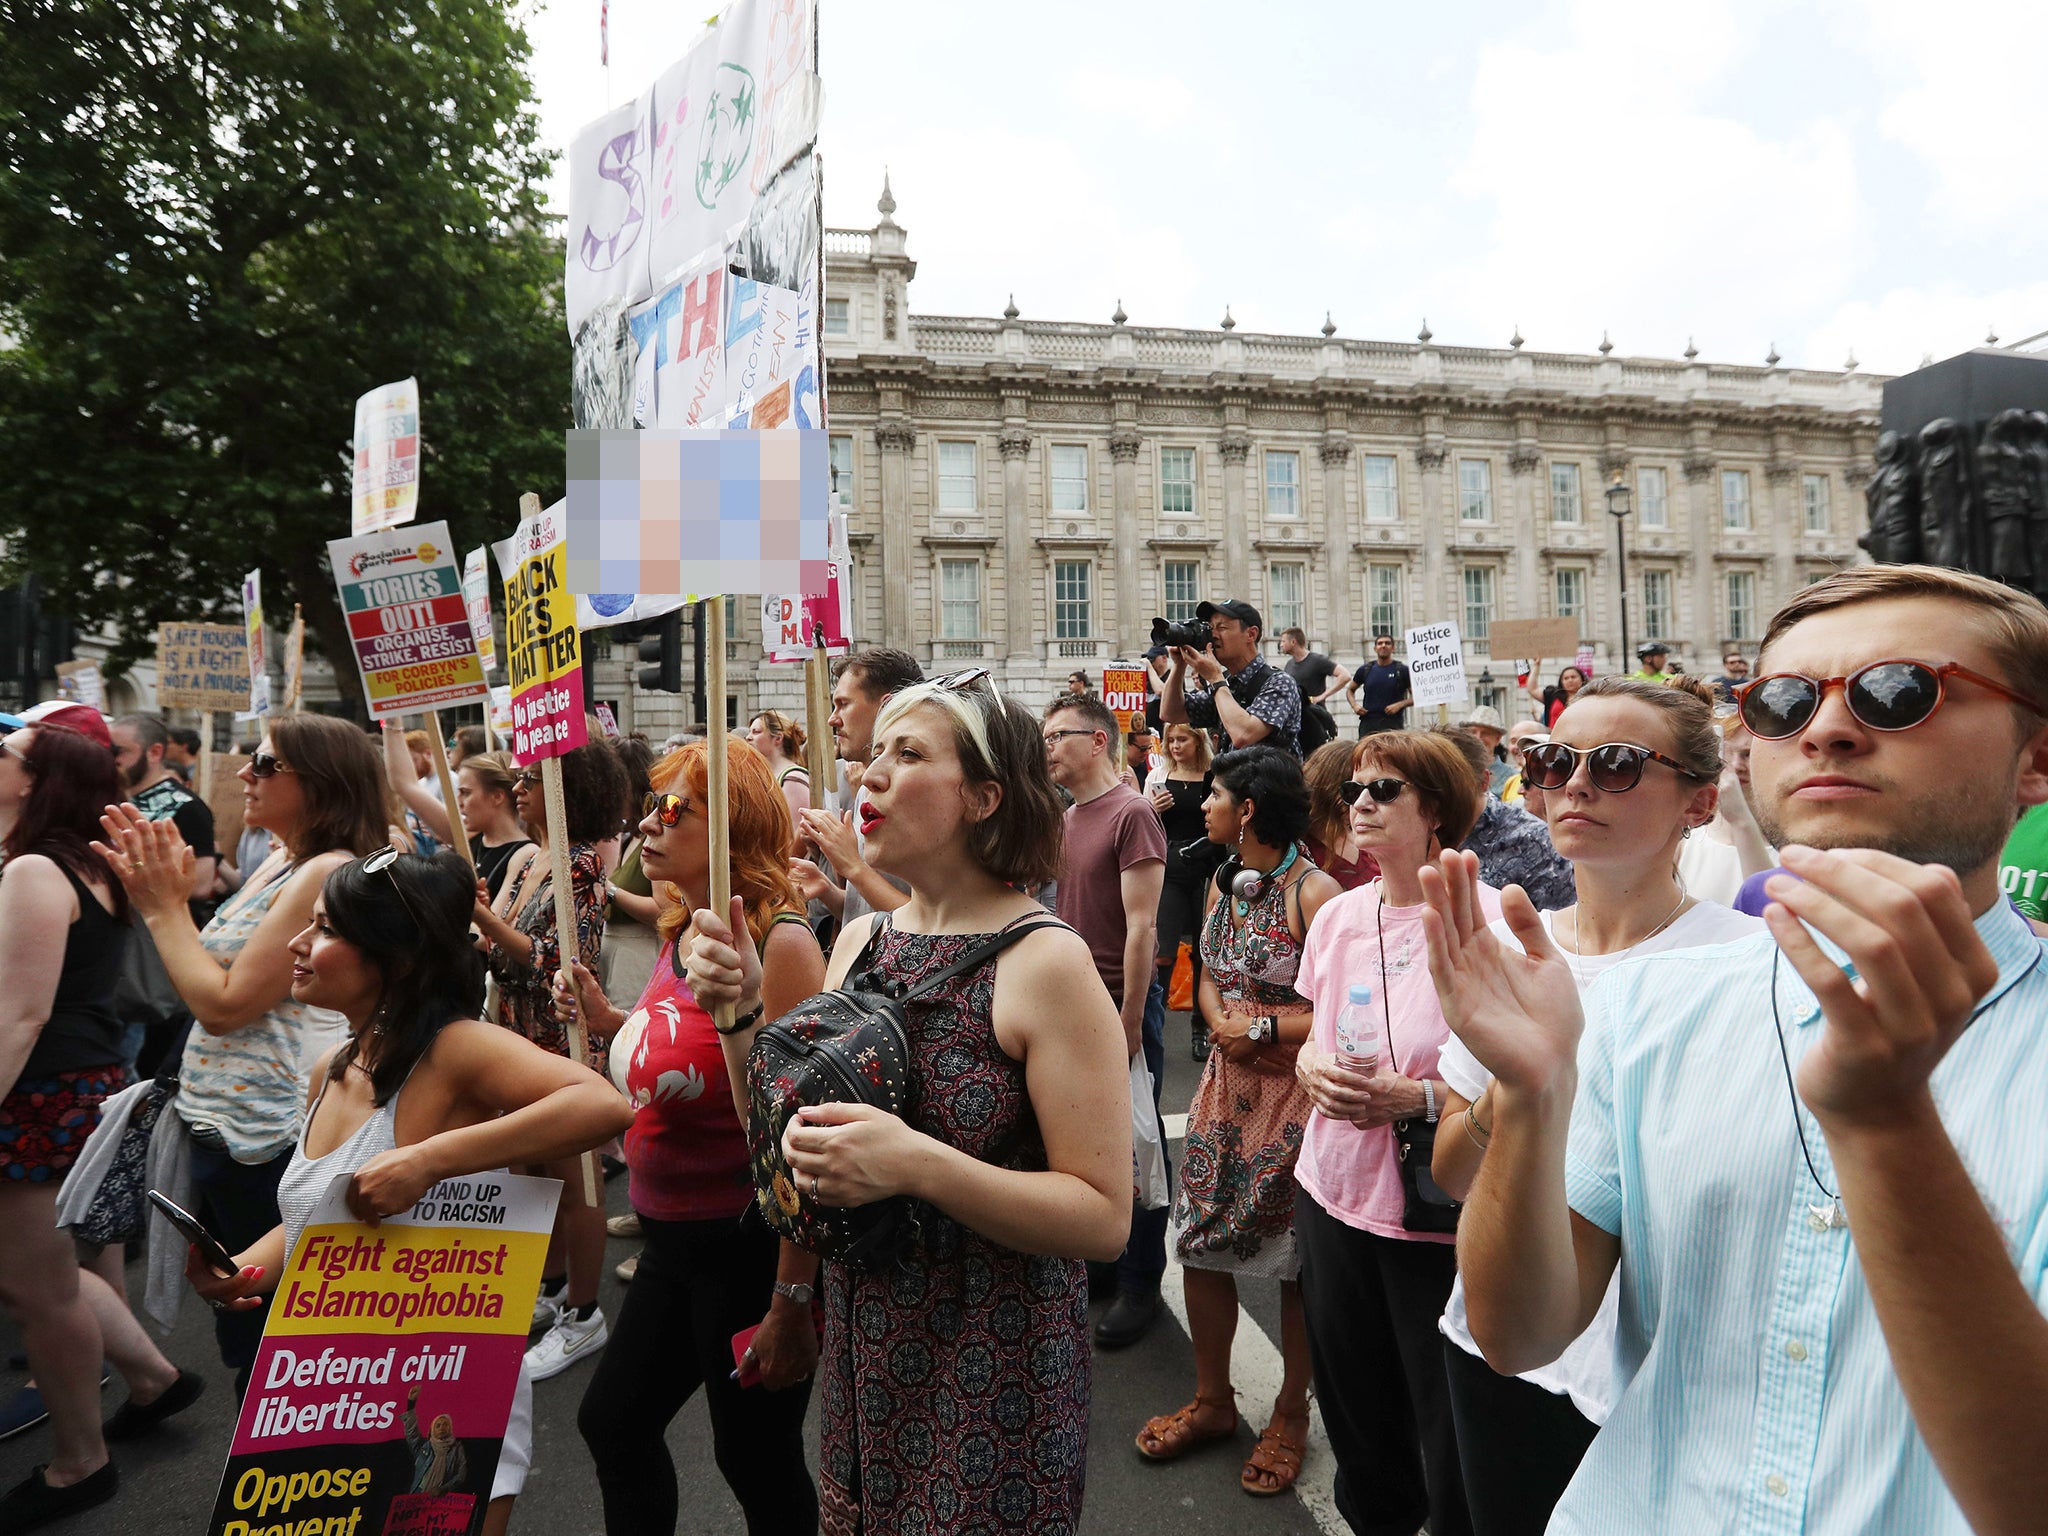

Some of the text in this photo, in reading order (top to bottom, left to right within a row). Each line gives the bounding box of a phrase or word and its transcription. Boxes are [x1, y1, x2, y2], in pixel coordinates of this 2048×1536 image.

[629, 267, 762, 371] THE
[543, 516, 552, 532] UP
[529, 528, 557, 551] RACISM
[359, 570, 443, 607] TORIES
[508, 553, 559, 616] BLACK
[379, 600, 437, 634] OUT!
[510, 597, 553, 652] LIVES
[164, 627, 198, 647] SAFE
[374, 626, 456, 653] ORGANISE,
[1412, 627, 1451, 644] Justice
[164, 648, 243, 671] IS A RIGHT
[362, 648, 418, 670] STRIKE,
[421, 638, 472, 660] RESIST
[511, 624, 577, 690] MATTER
[1424, 643, 1440, 656] for
[376, 669, 400, 685] FOR
[402, 657, 470, 678] CORBYN'S
[1412, 652, 1459, 673] Grenfell
[395, 674, 456, 695] POLICIES
[1106, 671, 1143, 681] KICK THE
[1107, 680, 1144, 692] TORIES
[1415, 669, 1460, 686] We demand
[381, 687, 478, 709] www.socialistparty.org.uk
[1105, 691, 1144, 710] OUT!
[1422, 682, 1455, 697] the truth
[513, 703, 526, 729] No
[526, 688, 570, 728] justice
[515, 730, 529, 755] No
[529, 718, 569, 751] peace
[423, 1181, 501, 1202] TAND UP
[412, 1202, 506, 1224] TO RACISM
[297, 1236, 507, 1283] Fight against
[282, 1281, 504, 1328] Islamophobia
[264, 1345, 467, 1389] Defend civil
[250, 1392, 397, 1439] liberties
[233, 1467, 372, 1518] Oppose
